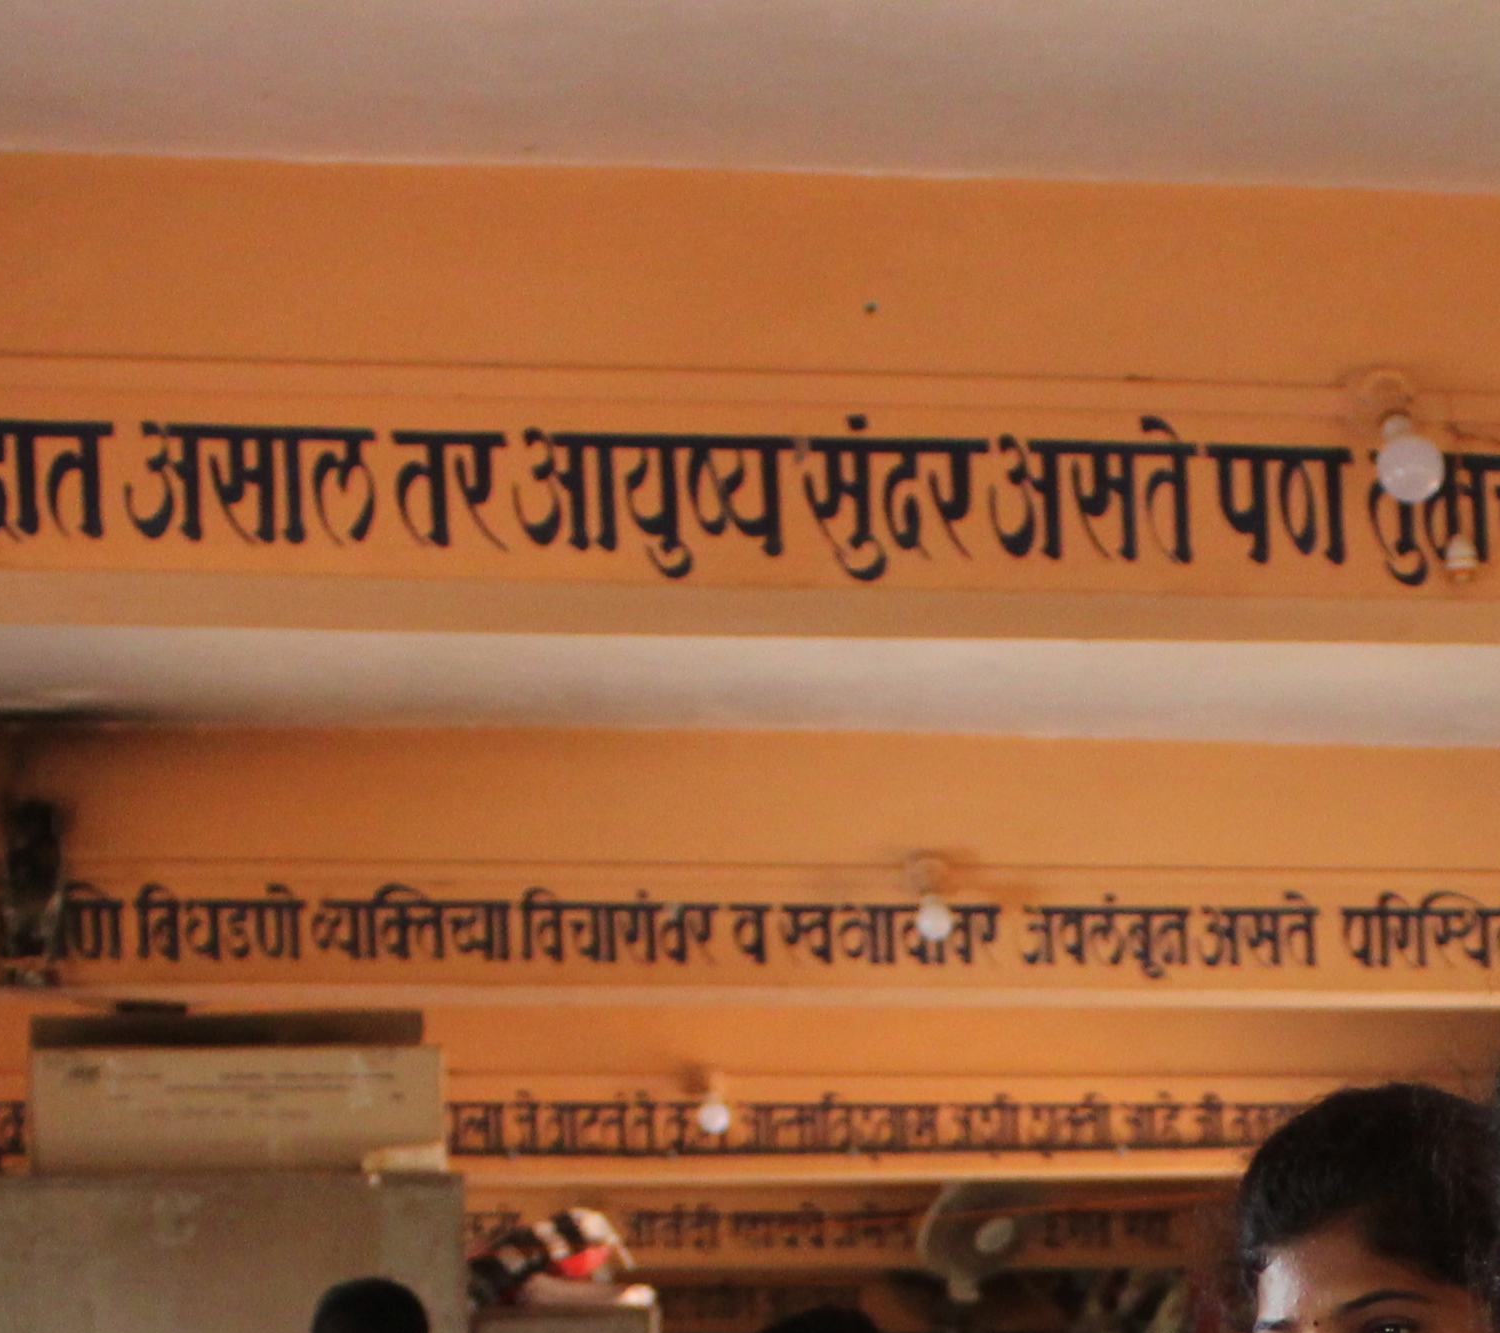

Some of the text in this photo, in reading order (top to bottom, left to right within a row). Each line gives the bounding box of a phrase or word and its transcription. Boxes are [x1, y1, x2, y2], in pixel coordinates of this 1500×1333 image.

[125, 422, 375, 544] असाल
[392, 431, 507, 547] तर
[514, 428, 790, 579] आयुष्य
[804, 415, 986, 581] सुंदर
[990, 416, 1198, 564] असते
[1206, 444, 1353, 564] पण
[729, 904, 770, 964] व
[1202, 892, 1319, 967] असते
